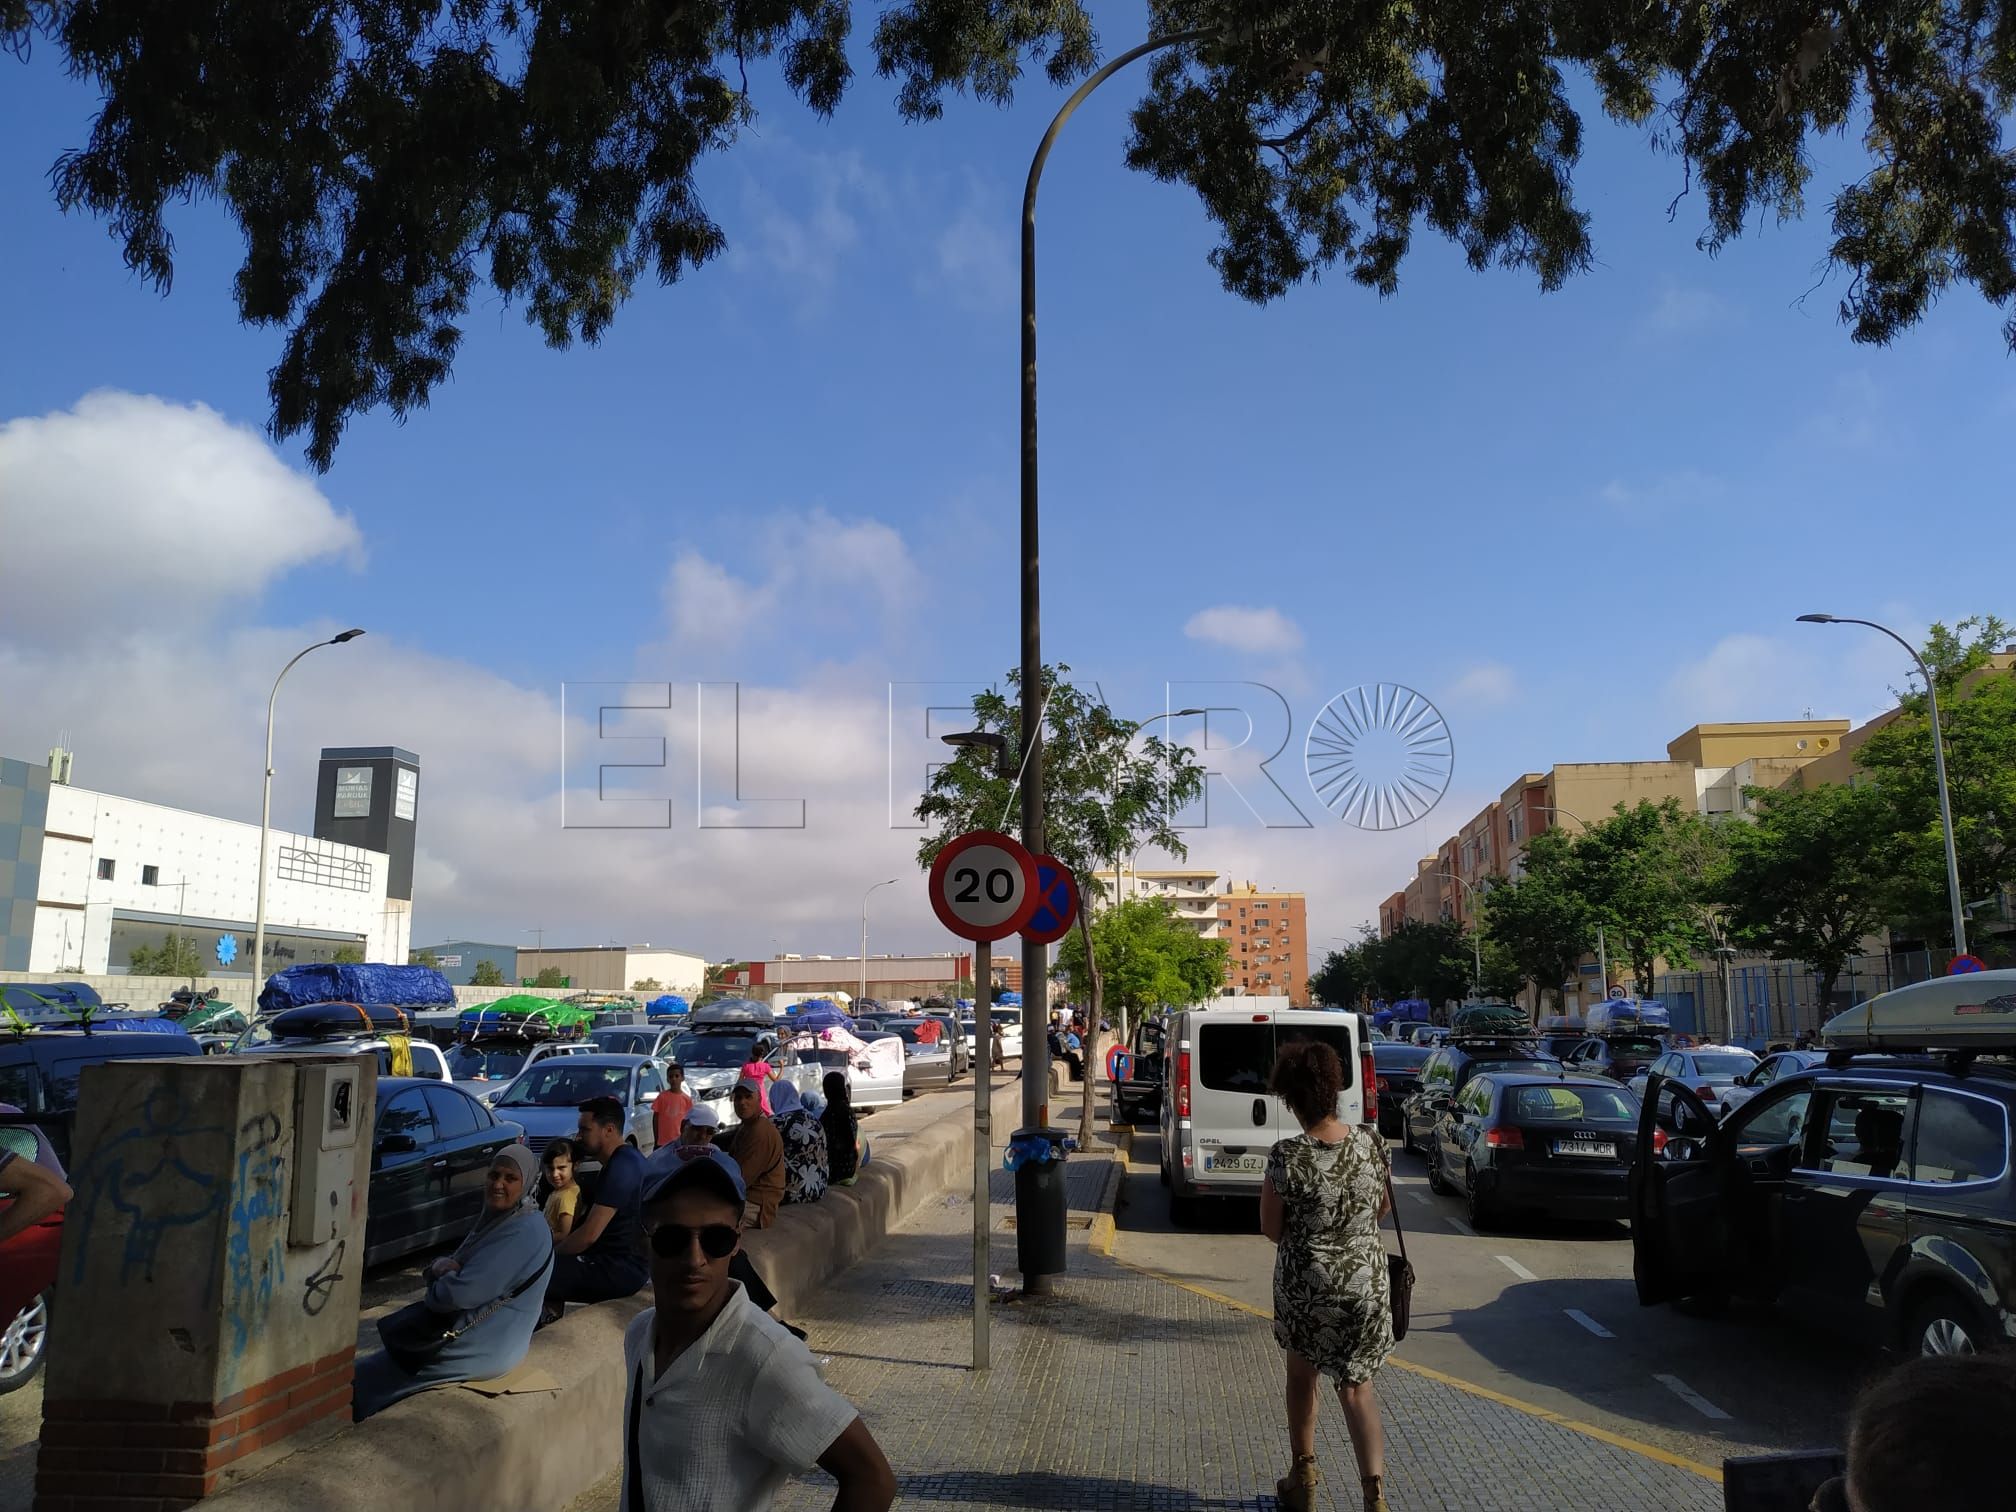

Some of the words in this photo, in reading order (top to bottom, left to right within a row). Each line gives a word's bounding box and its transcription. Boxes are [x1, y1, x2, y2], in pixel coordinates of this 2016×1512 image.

[954, 867, 1015, 904] 20
[1561, 1140, 1587, 1153] 7314
[1593, 1143, 1612, 1154] MDR
[1213, 1158, 1240, 1169] 2429
[1243, 1158, 1264, 1169] GZJ
